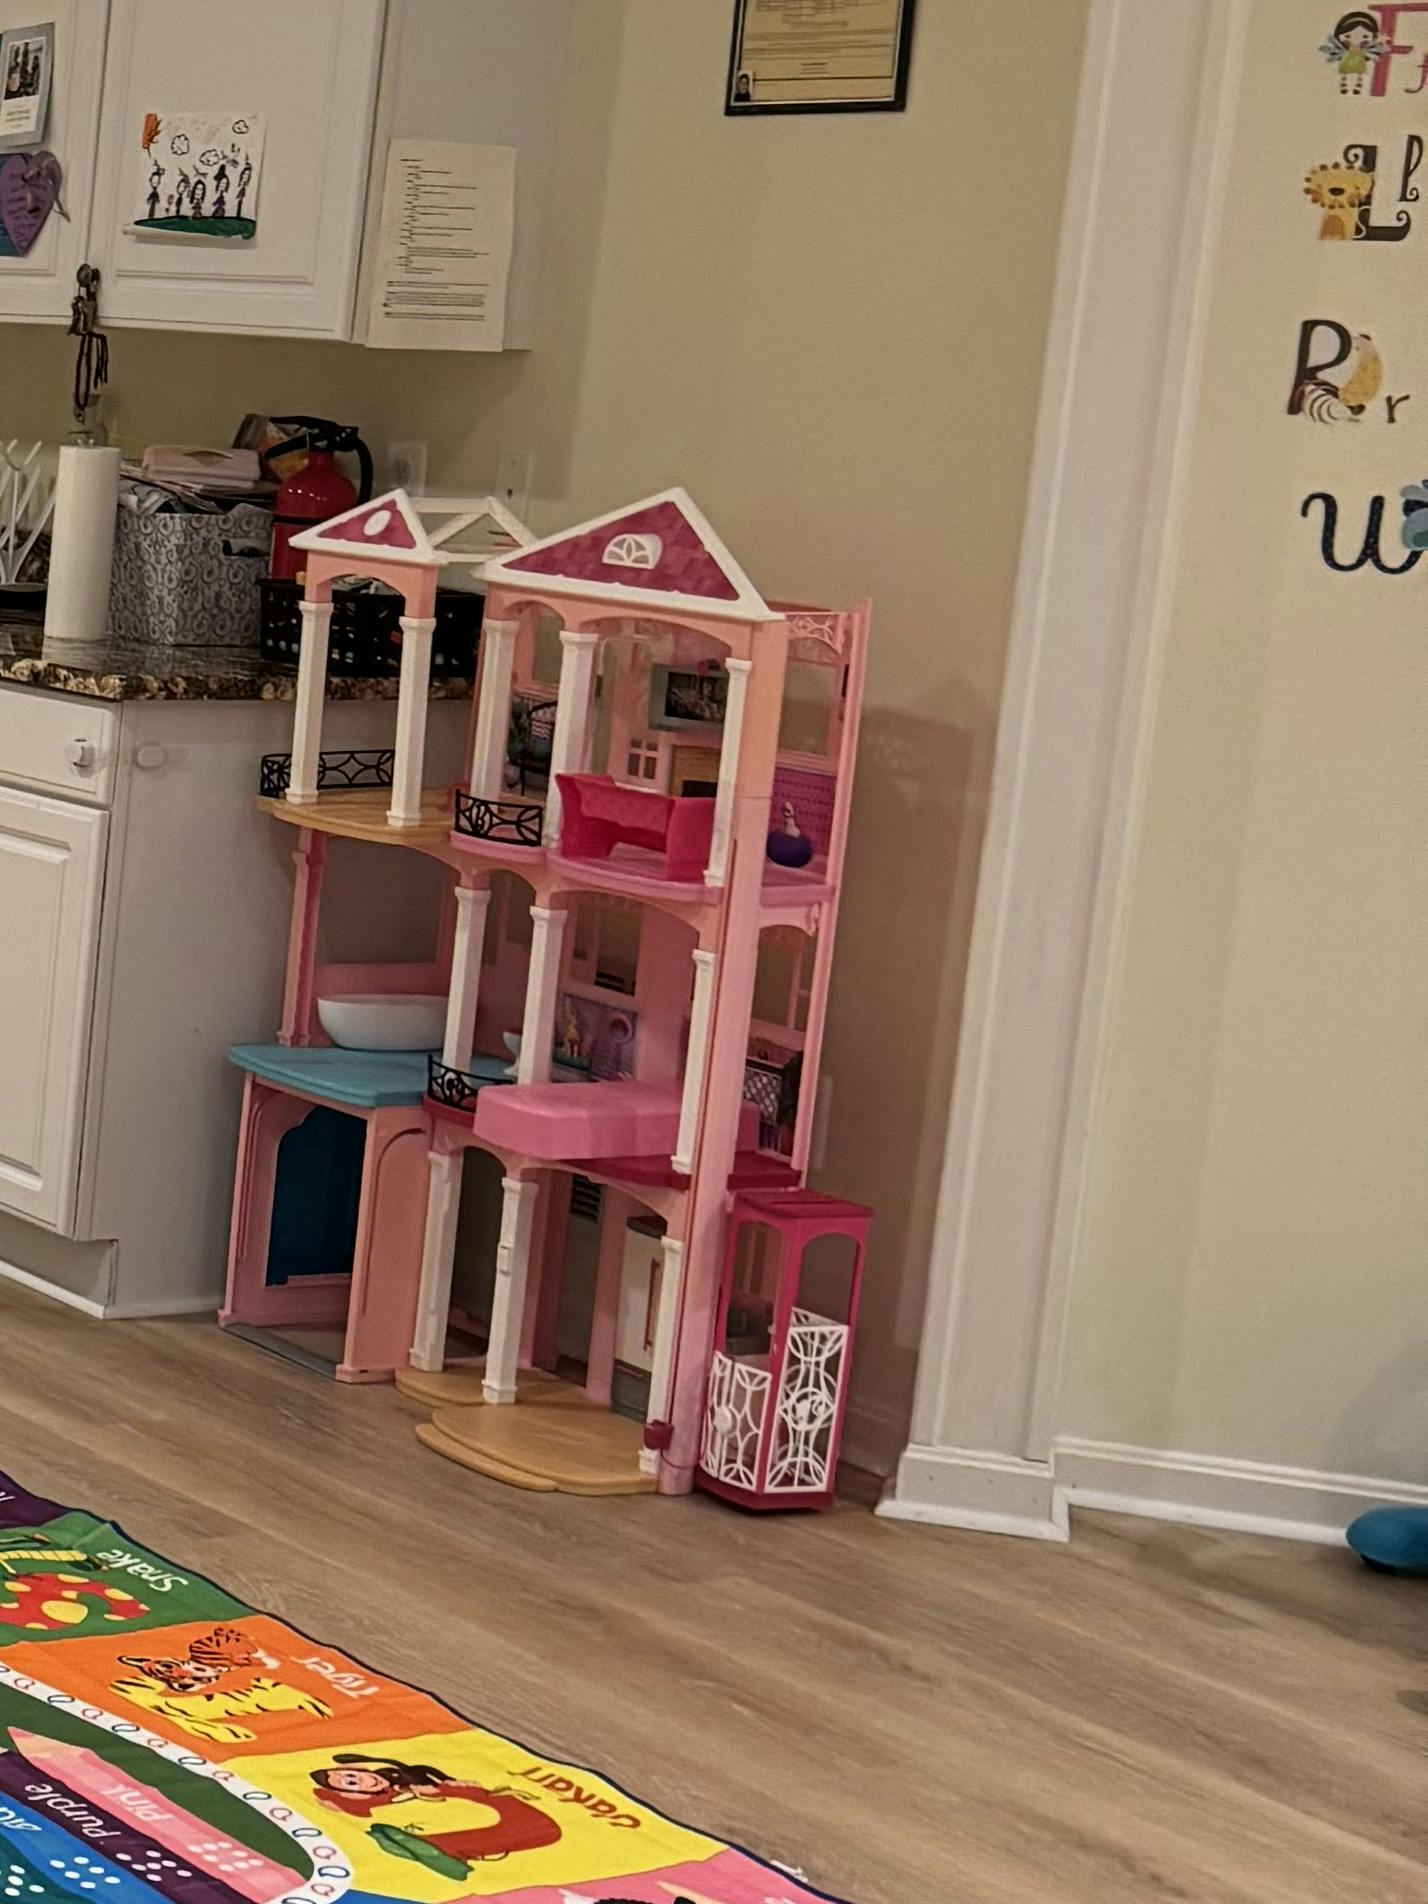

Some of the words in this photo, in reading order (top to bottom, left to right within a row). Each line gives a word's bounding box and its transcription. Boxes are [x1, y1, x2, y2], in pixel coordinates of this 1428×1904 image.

[96, 1549, 188, 1591] Snake
[291, 1657, 379, 1697] Tiger
[110, 1672, 333, 1742] T
[24, 1783, 121, 1837] Purple
